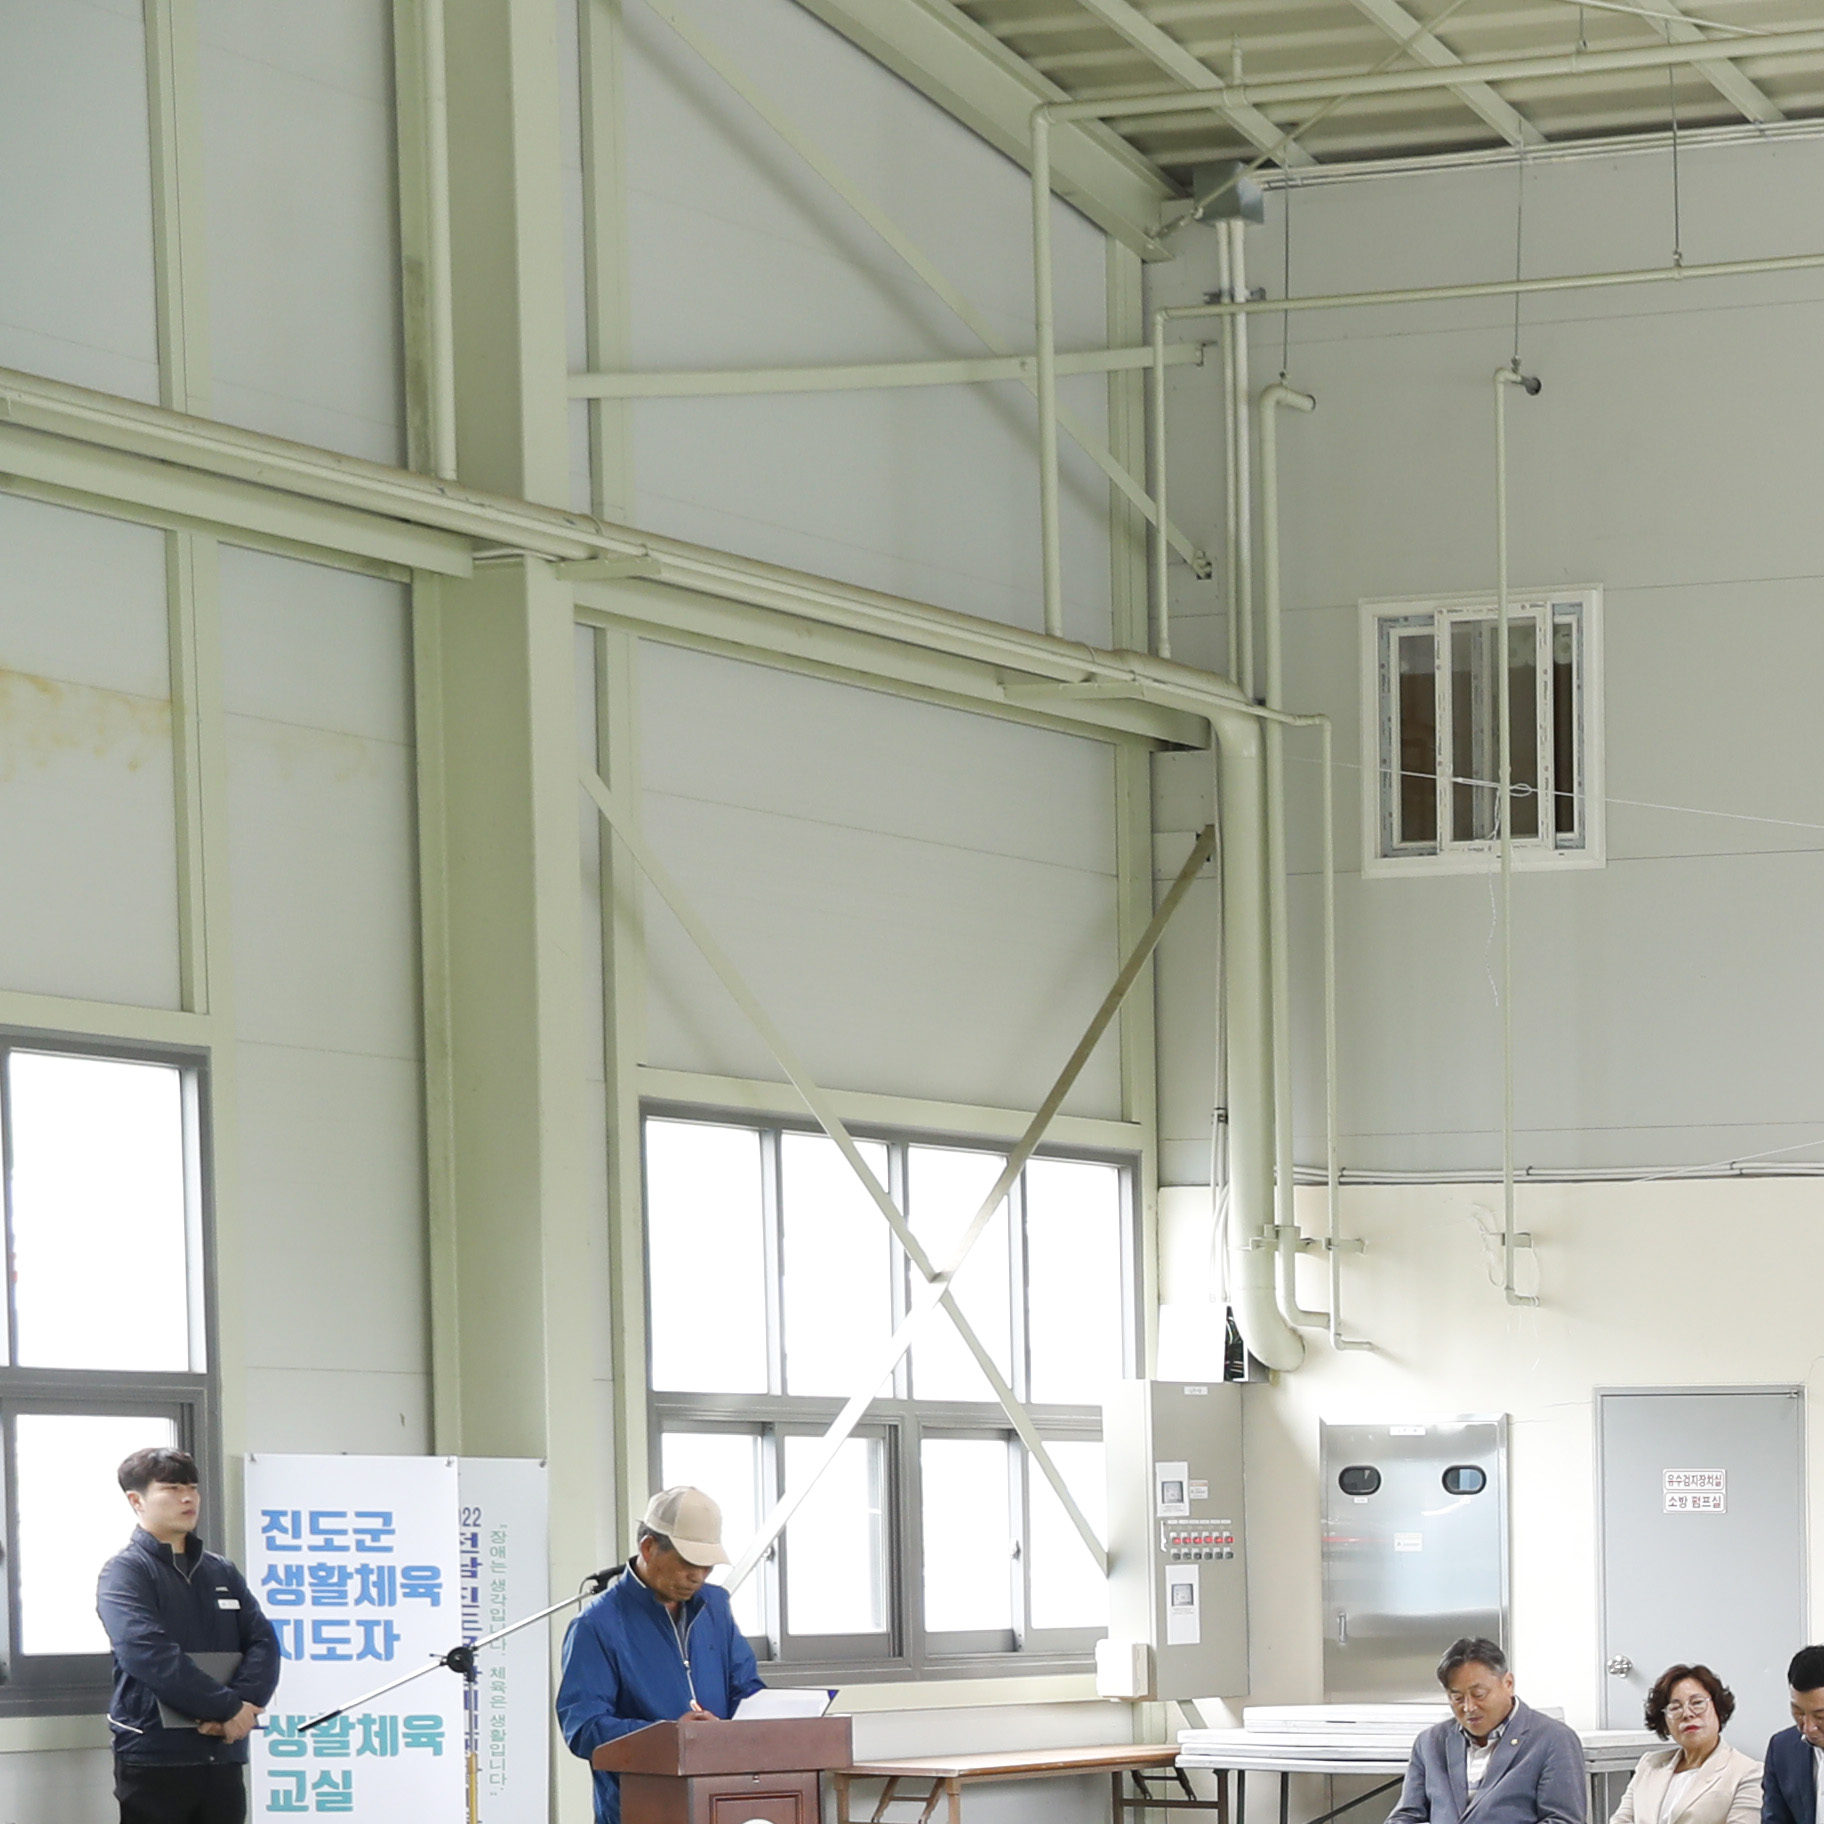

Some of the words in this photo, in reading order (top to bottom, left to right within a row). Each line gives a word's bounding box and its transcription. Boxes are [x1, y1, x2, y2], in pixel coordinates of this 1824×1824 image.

[1667, 1474, 1722, 1487] 유수검지장치실
[1668, 1495, 1688, 1509] 소방
[1691, 1494, 1722, 1509] 펌프실
[261, 1509, 397, 1554] 진도군
[261, 1563, 443, 1607] 생활체육
[490, 1666, 508, 1709] 체육은
[262, 1715, 445, 1758] 생활체육
[265, 1769, 355, 1814] 교실
